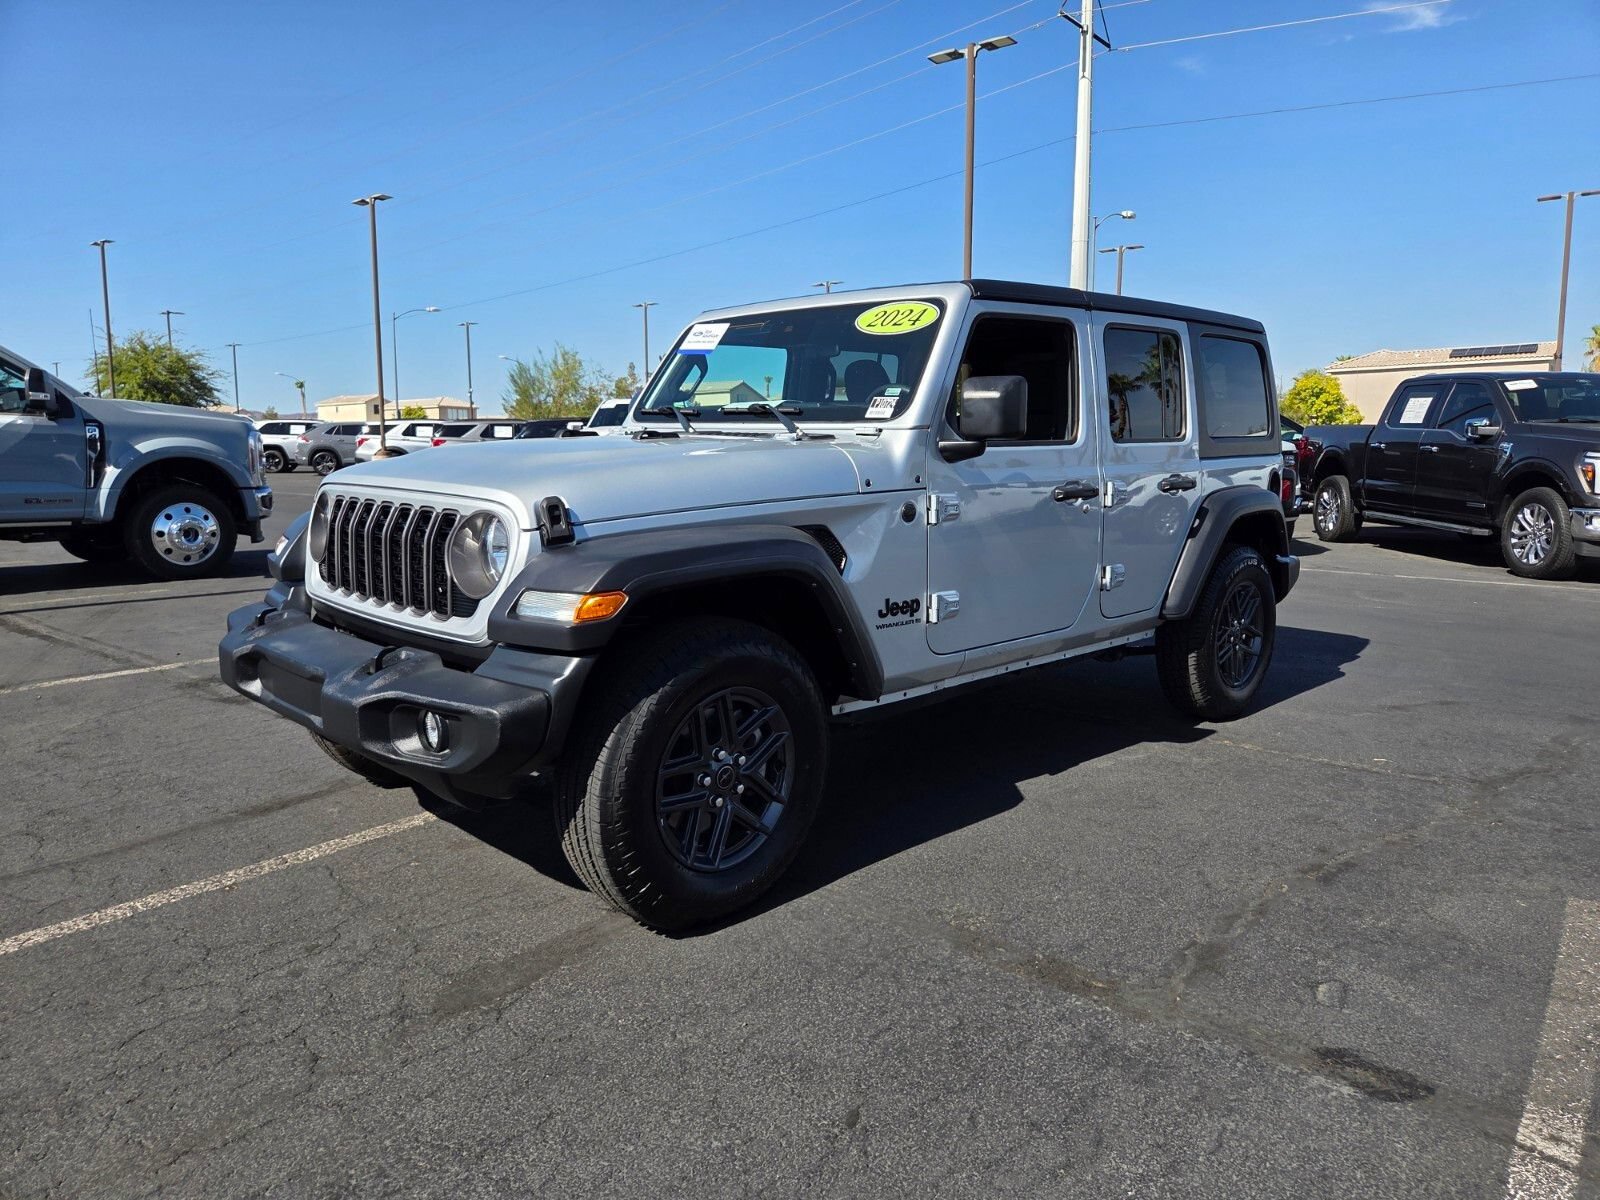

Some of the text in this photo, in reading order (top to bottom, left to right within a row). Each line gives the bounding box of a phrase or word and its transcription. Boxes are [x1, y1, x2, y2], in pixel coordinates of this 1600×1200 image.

[866, 308, 928, 327] 2024
[878, 598, 921, 618] Jeep
[875, 619, 914, 630] WRANGLER
